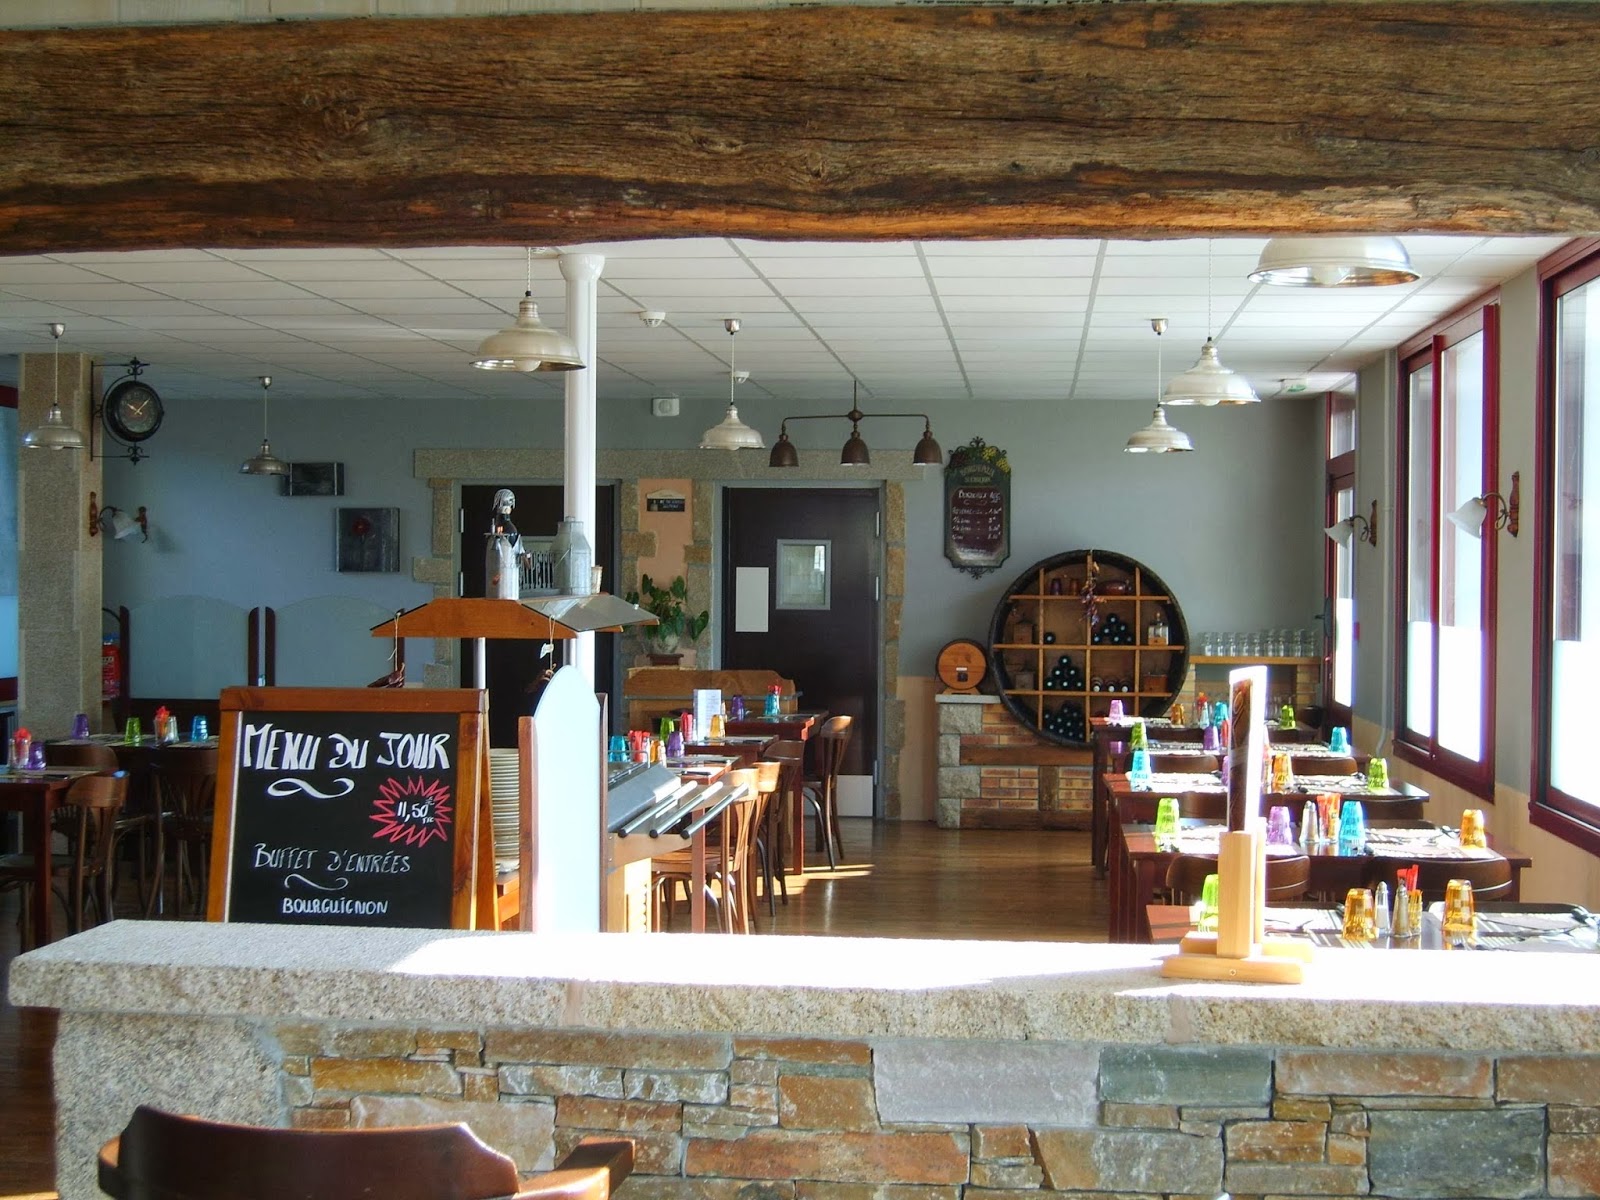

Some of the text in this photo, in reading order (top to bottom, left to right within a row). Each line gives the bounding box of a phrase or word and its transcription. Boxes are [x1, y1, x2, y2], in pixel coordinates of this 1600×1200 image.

[243, 723, 451, 770] MENU DU JOUR
[254, 843, 411, 873] BUFFET D'ENTRÉES
